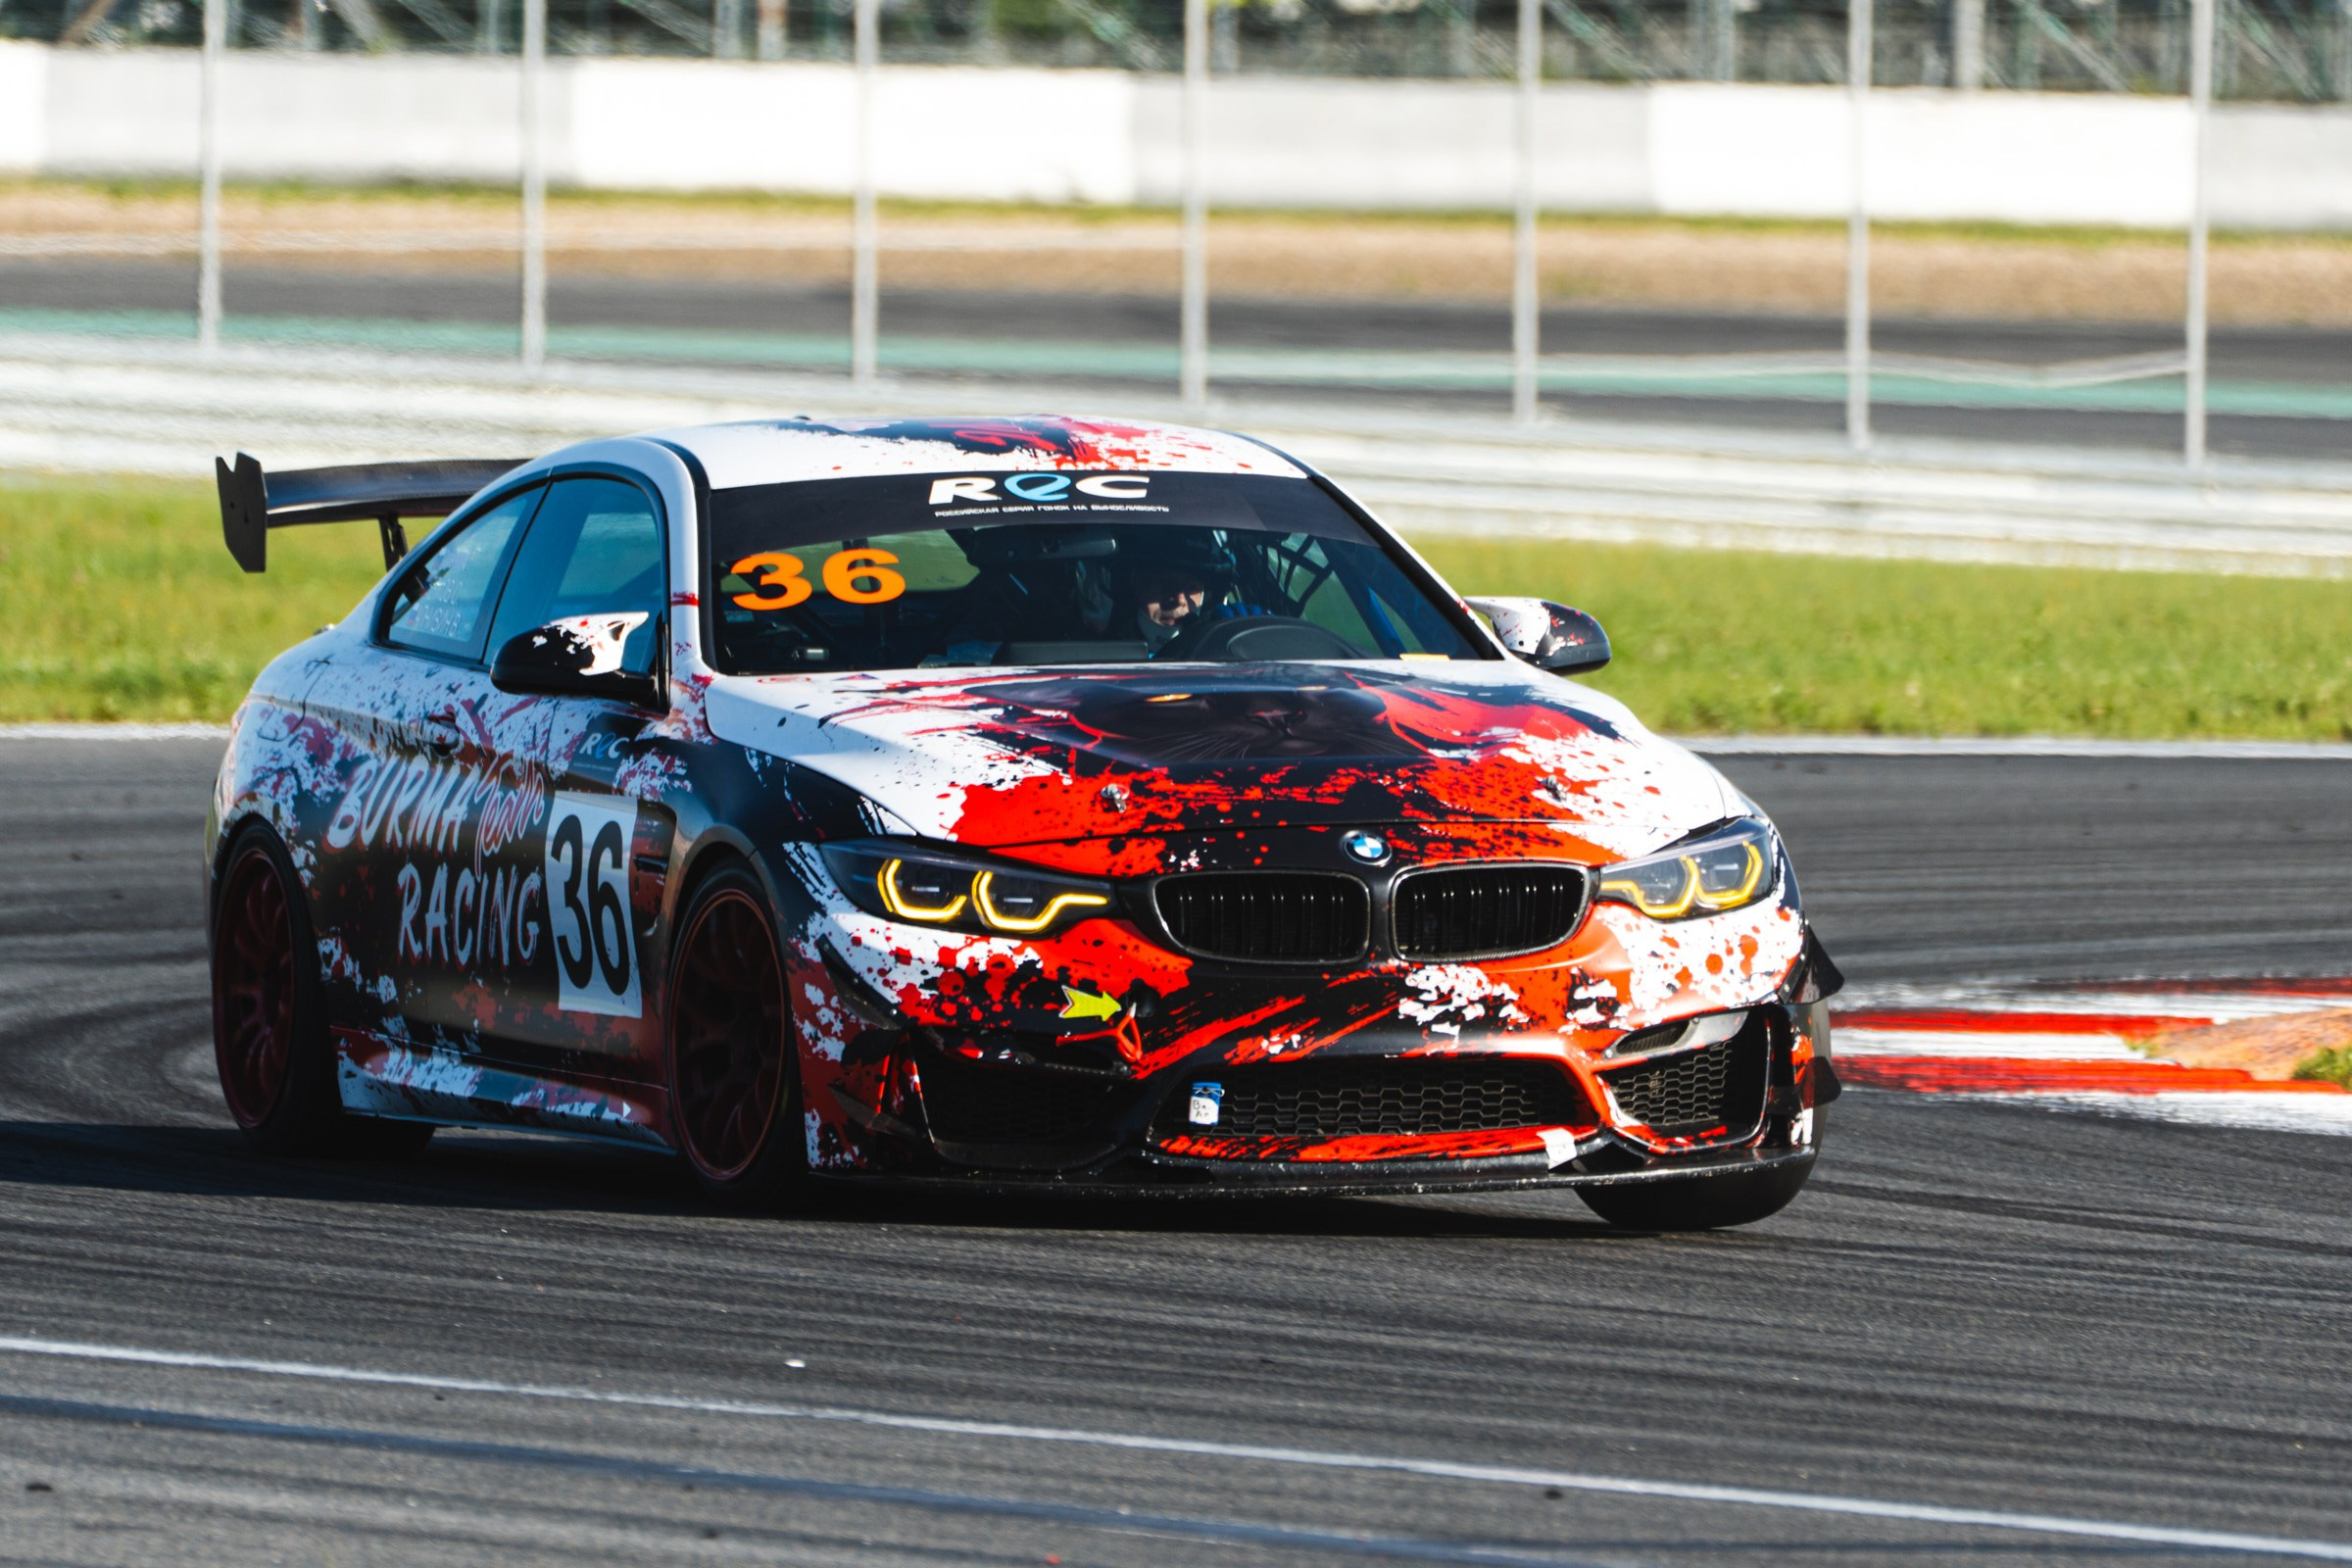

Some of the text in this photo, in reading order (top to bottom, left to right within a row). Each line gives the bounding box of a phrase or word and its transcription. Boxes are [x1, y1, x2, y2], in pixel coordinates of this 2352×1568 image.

[730, 548, 906, 611] 36
[325, 755, 481, 855] BURMA
[397, 861, 541, 967] RACING
[551, 814, 630, 996] 36
